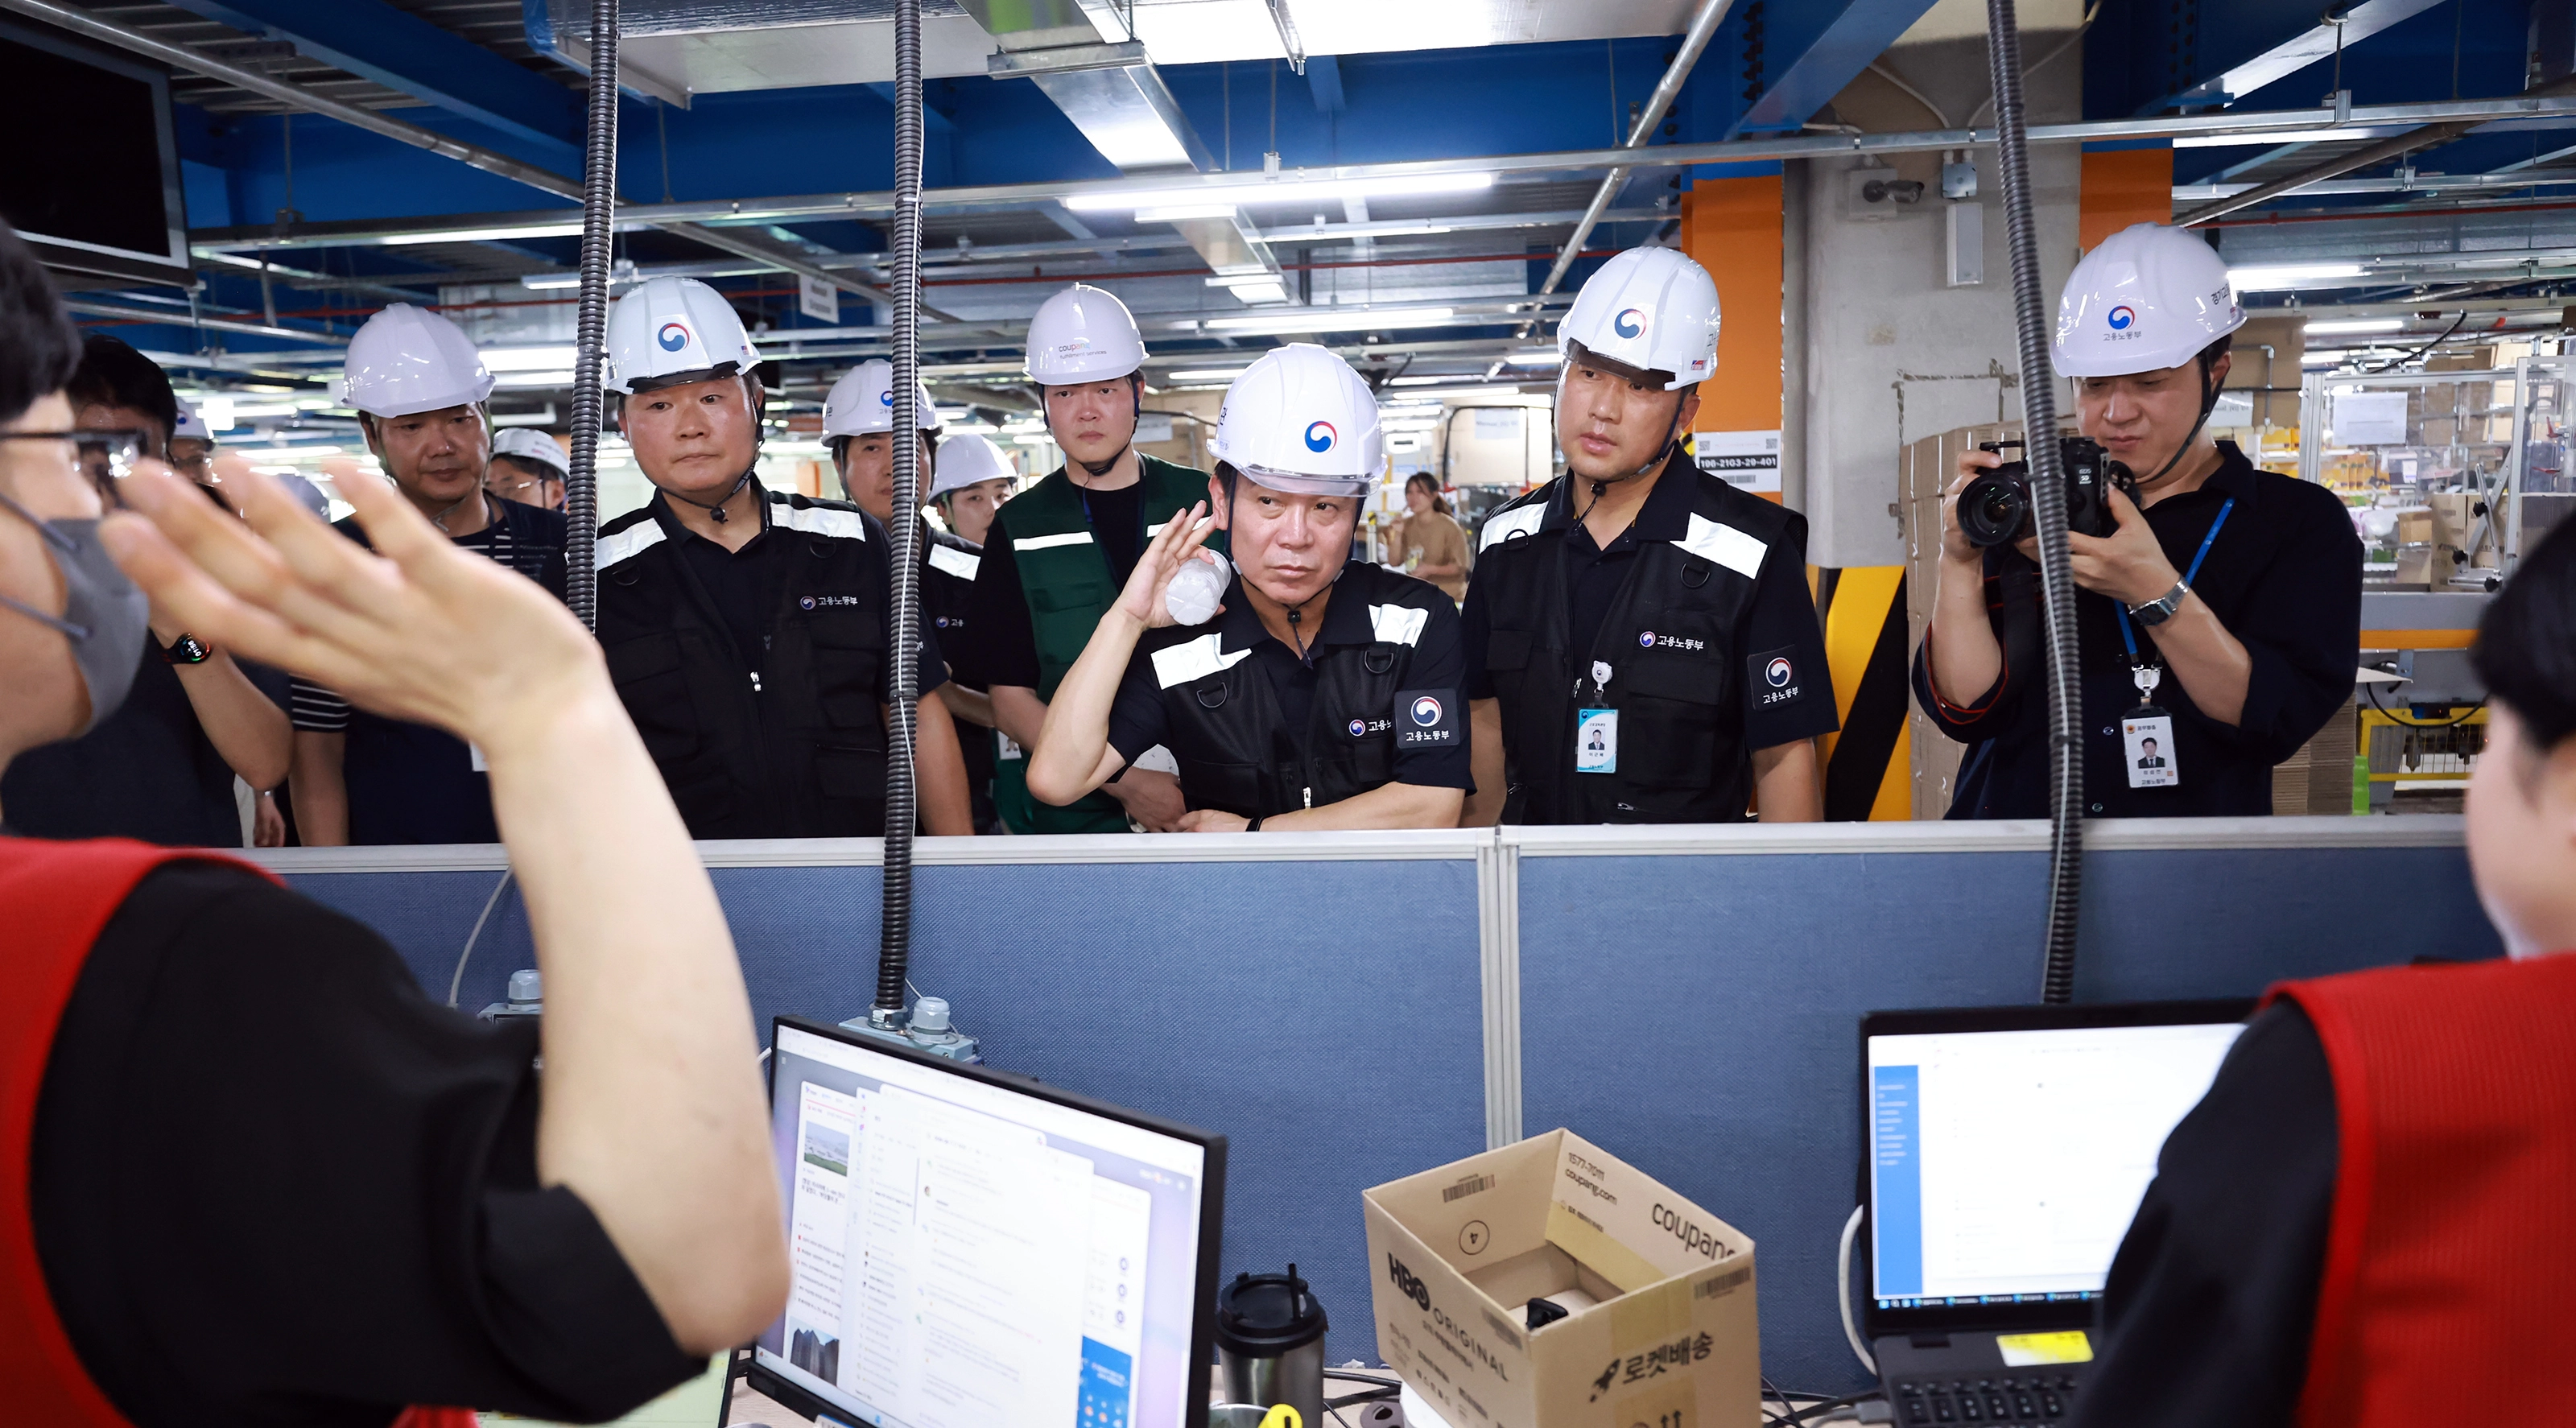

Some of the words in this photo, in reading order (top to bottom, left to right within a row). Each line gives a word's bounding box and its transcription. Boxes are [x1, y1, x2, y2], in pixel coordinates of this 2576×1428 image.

[2103, 331, 2142, 341] 고용노동부
[1059, 342, 1091, 353] coupang
[818, 596, 858, 606] 고용노동부
[1657, 635, 1704, 651] 고용노동부
[1762, 686, 1799, 704] 고용노동부
[1406, 730, 1450, 742] 고용노동부
[1568, 1152, 1605, 1182] 1577-7011
[1565, 1169, 1617, 1206] coupang.com
[1388, 1252, 1430, 1311] HBO
[1433, 1307, 1509, 1382] ORIGINAL
[1622, 1331, 1714, 1385] 로켓배송
